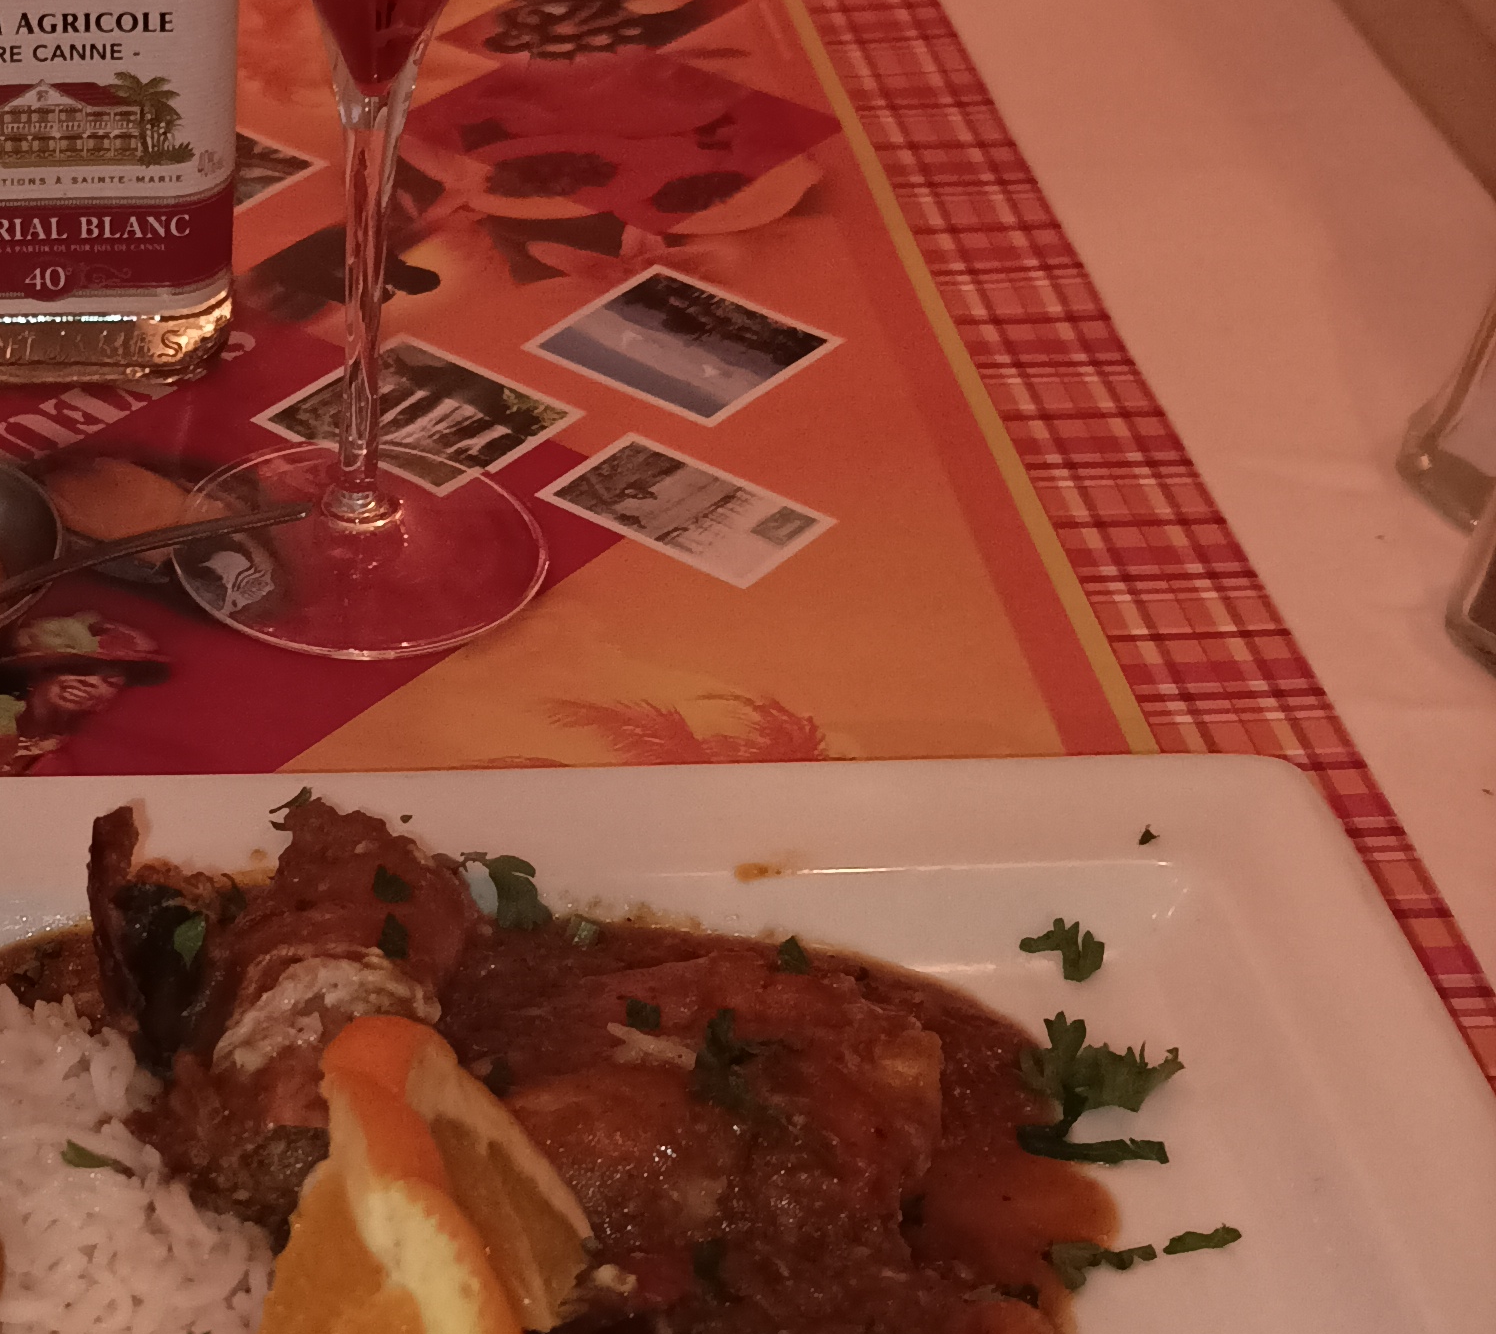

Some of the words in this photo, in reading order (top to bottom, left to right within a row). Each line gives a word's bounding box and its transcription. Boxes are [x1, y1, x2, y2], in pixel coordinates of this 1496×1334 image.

[15, 11, 175, 35] AGRICOLE
[32, 43, 124, 62] CANNE
[71, 175, 184, 185] SAINTE-MARIE
[79, 214, 191, 239] BLANC
